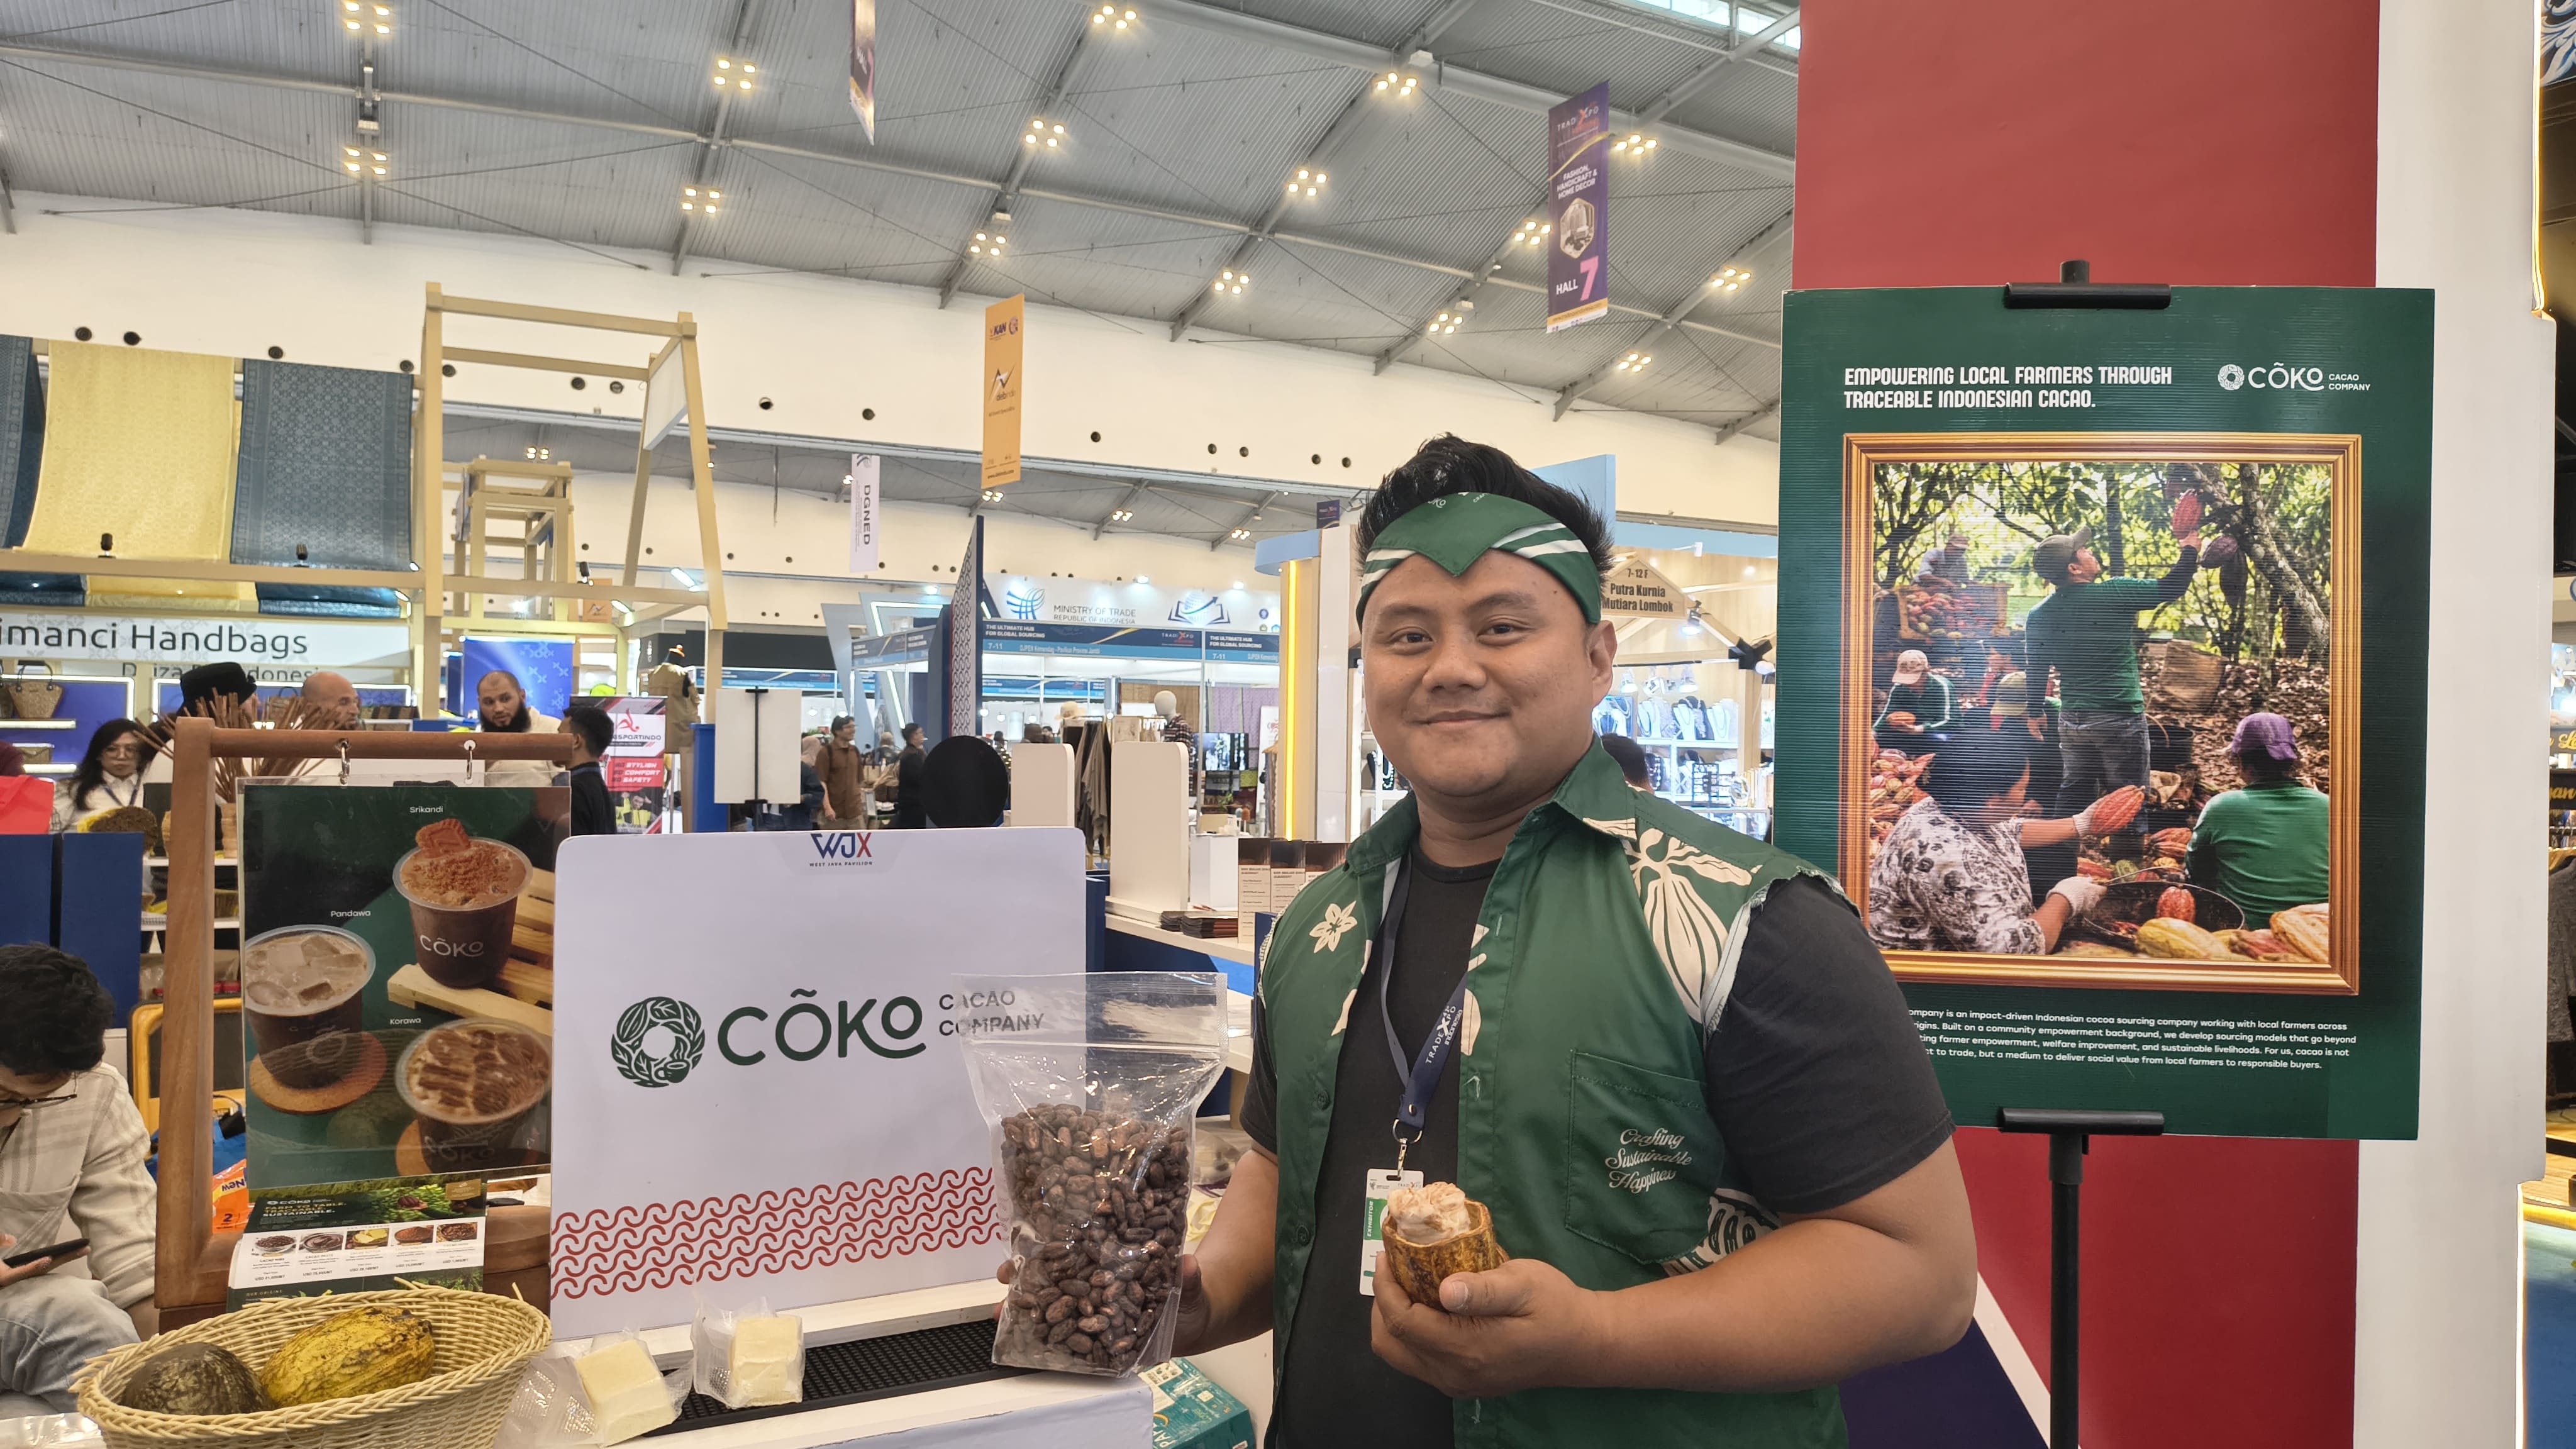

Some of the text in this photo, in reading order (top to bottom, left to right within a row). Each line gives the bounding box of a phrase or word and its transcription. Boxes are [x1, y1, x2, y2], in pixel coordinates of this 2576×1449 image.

[1557, 169, 1598, 192] HANDICRAFT &
[1563, 164, 1589, 180] FASHION,
[1558, 178, 1596, 199] HOME DECOR
[1556, 255, 1599, 301] HALL 7
[1845, 366, 2172, 386] EMPOWERING LOCAL FARMERS THROUGH
[2328, 383, 2370, 391] COMPANY
[1844, 389, 2096, 408] TRACEABLE INDONESIAN CACAO.
[1610, 583, 1665, 598] Putra Kurnia
[1054, 605, 1092, 614] MINISTRY
[1109, 608, 1136, 616] TRADE
[1602, 598, 1673, 613] Mutiara Lombok
[131, 625, 308, 659] Handbags
[810, 832, 872, 859] WJX
[390, 1017, 421, 1025] Korawa
[1909, 1009, 1944, 1018] ompany
[1946, 1009, 1953, 1018] is
[1969, 1010, 2033, 1021] impact-driven
[2035, 1013, 2084, 1023] Indonesian
[2086, 1016, 2114, 1024] cocoa
[2117, 1017, 2155, 1026] sourcing
[2157, 1019, 2198, 1028] company
[2201, 1019, 2235, 1029] working
[2237, 1020, 2256, 1028] with
[2281, 1021, 2316, 1030] farmers
[1914, 1021, 1940, 1030] igins.
[1942, 1023, 1962, 1031] Built
[1986, 1024, 2036, 1035] community
[2038, 1027, 2104, 1037] empowerment
[2106, 1029, 2162, 1040] background,
[2179, 1031, 2214, 1041] develop
[2216, 1033, 2253, 1043] sourcing
[2255, 1034, 2287, 1042] models
[2289, 1035, 2309, 1043] that
[2324, 1036, 2357, 1045] beyond
[1939, 1035, 1970, 1044] farmer
[1972, 1038, 2040, 1048] empowerment,
[2043, 1039, 2076, 1048] welfare
[2078, 1040, 2140, 1052] improvement,
[2142, 1043, 2159, 1051] and
[2161, 1043, 2212, 1053] sustainable
[2214, 1045, 2262, 1054] livelihoods.
[2265, 1046, 2279, 1055] For
[2325, 1048, 2332, 1056] is
[1949, 1049, 1977, 1058] trade,
[1979, 1050, 1995, 1058] but
[2006, 1051, 2041, 1060] medium
[2055, 1053, 2085, 1062] deliver
[2087, 1054, 2114, 1063] social
[2116, 1055, 2140, 1063] value
[2189, 1058, 2224, 1066] farmers
[2238, 1060, 2288, 1069] responsible
[2290, 1060, 2322, 1070] buyers.
[1620, 1128, 1685, 1149] Crafting
[1605, 1148, 1692, 1169] Sustainable
[221, 1179, 245, 1192] New
[223, 1213, 233, 1222] 2
